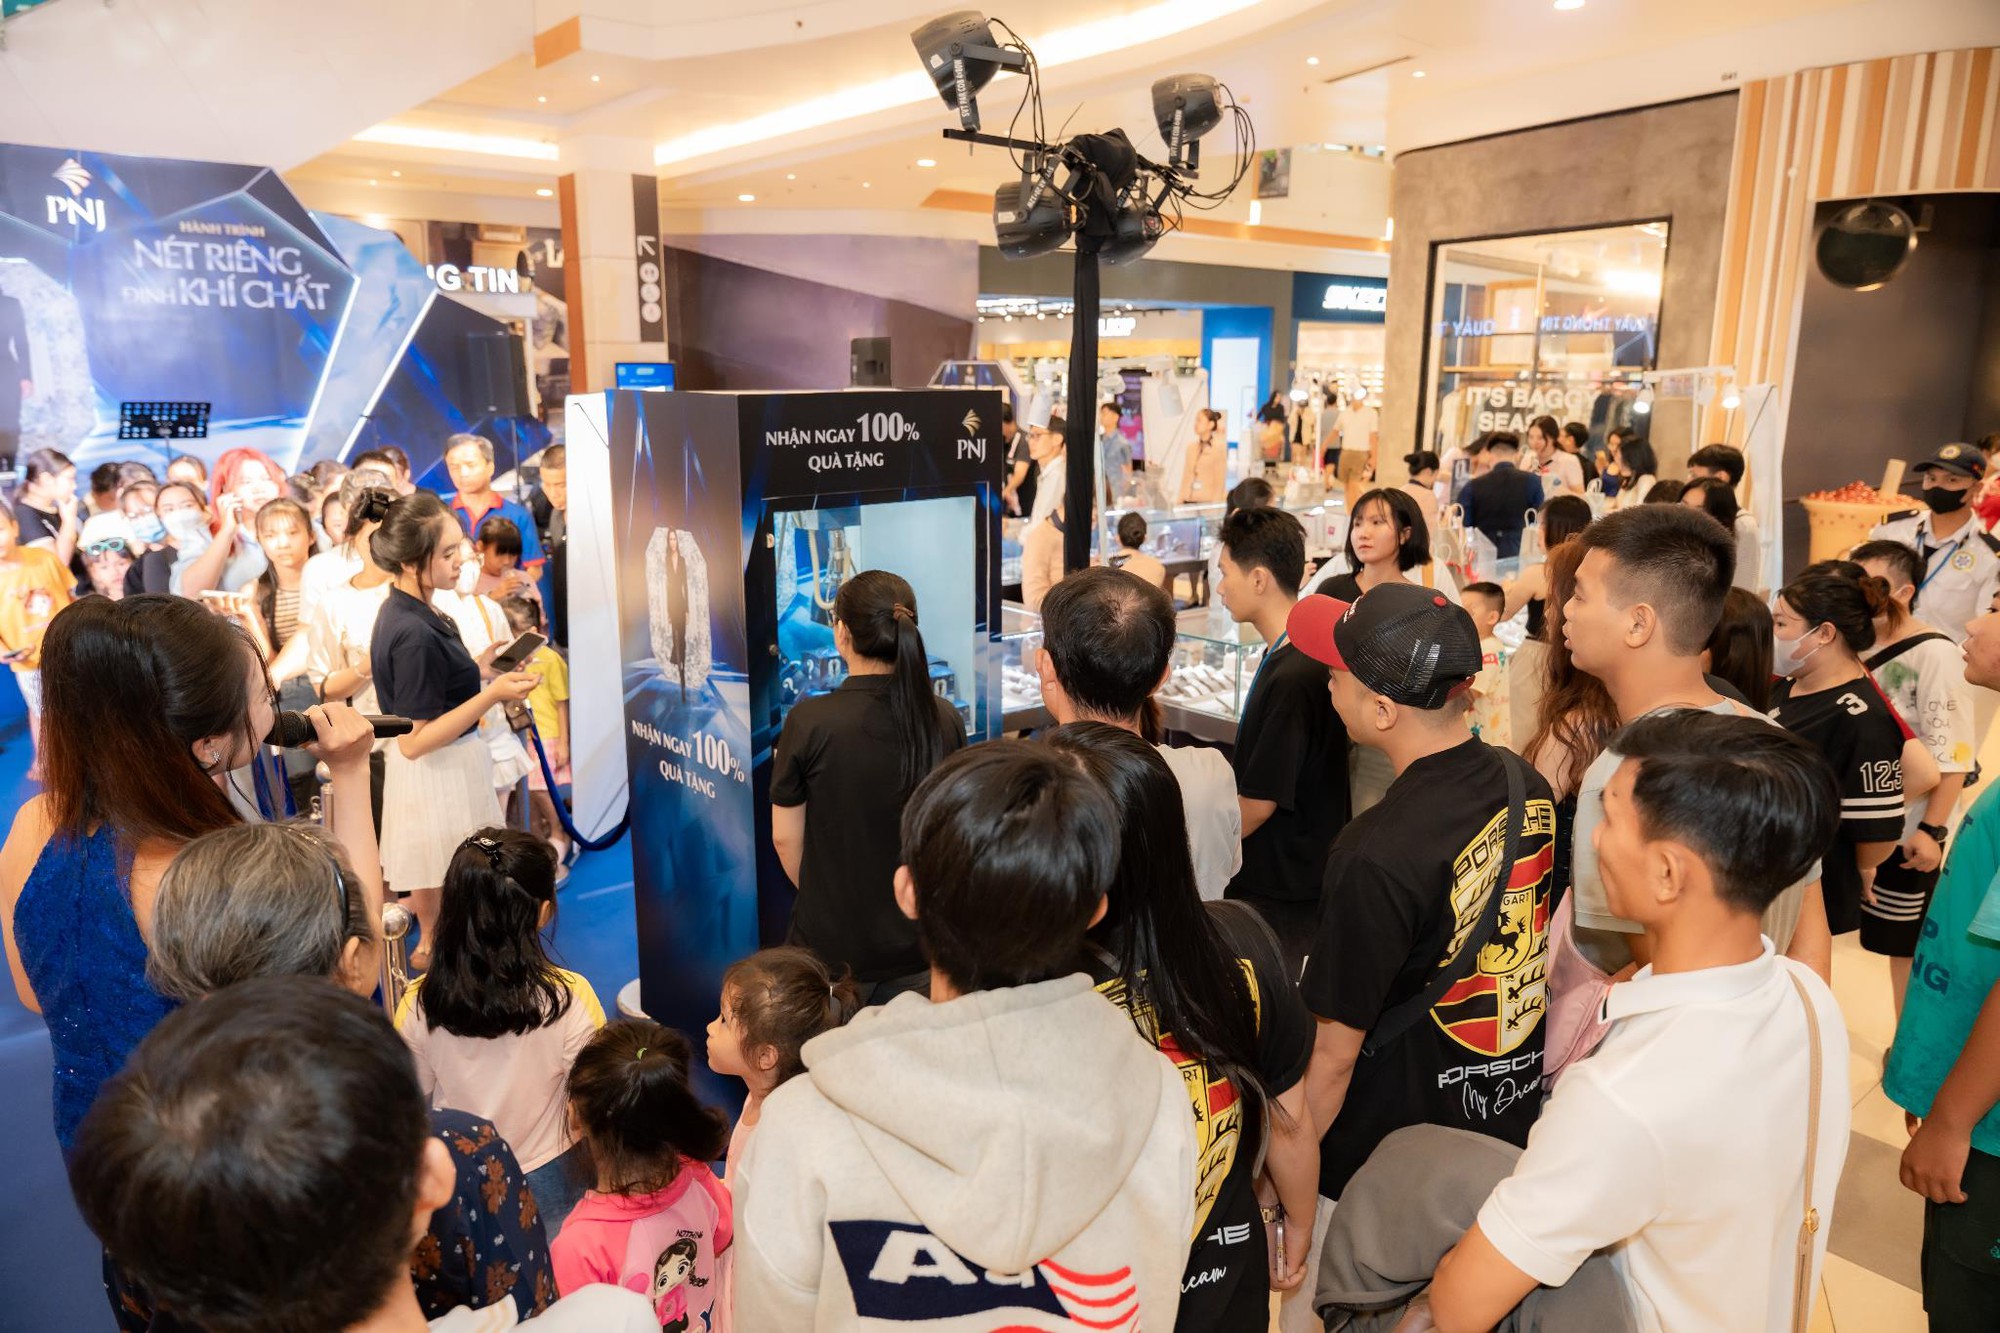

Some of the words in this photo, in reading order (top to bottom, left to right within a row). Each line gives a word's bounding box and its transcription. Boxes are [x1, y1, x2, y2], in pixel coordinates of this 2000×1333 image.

[46, 195, 106, 232] PNJ
[133, 234, 199, 271] NÉT
[204, 238, 301, 276] RIÊNG
[179, 273, 237, 307] KHÍ
[241, 273, 330, 310] CHẤT
[467, 265, 519, 293] TIN
[1466, 386, 1506, 408] IT'S
[766, 427, 811, 448] NHẬN
[815, 428, 856, 444] NGAY
[857, 412, 920, 442] 100%
[808, 452, 842, 473] QUÀ
[844, 451, 884, 471] TẶNG
[957, 438, 987, 464] PNJ
[1836, 692, 1869, 715] 3
[631, 720, 661, 746] NHẬN
[662, 733, 692, 759] NGAY
[692, 730, 745, 783] 100%
[659, 760, 684, 784] QUÀ
[685, 771, 715, 798] TẶNG
